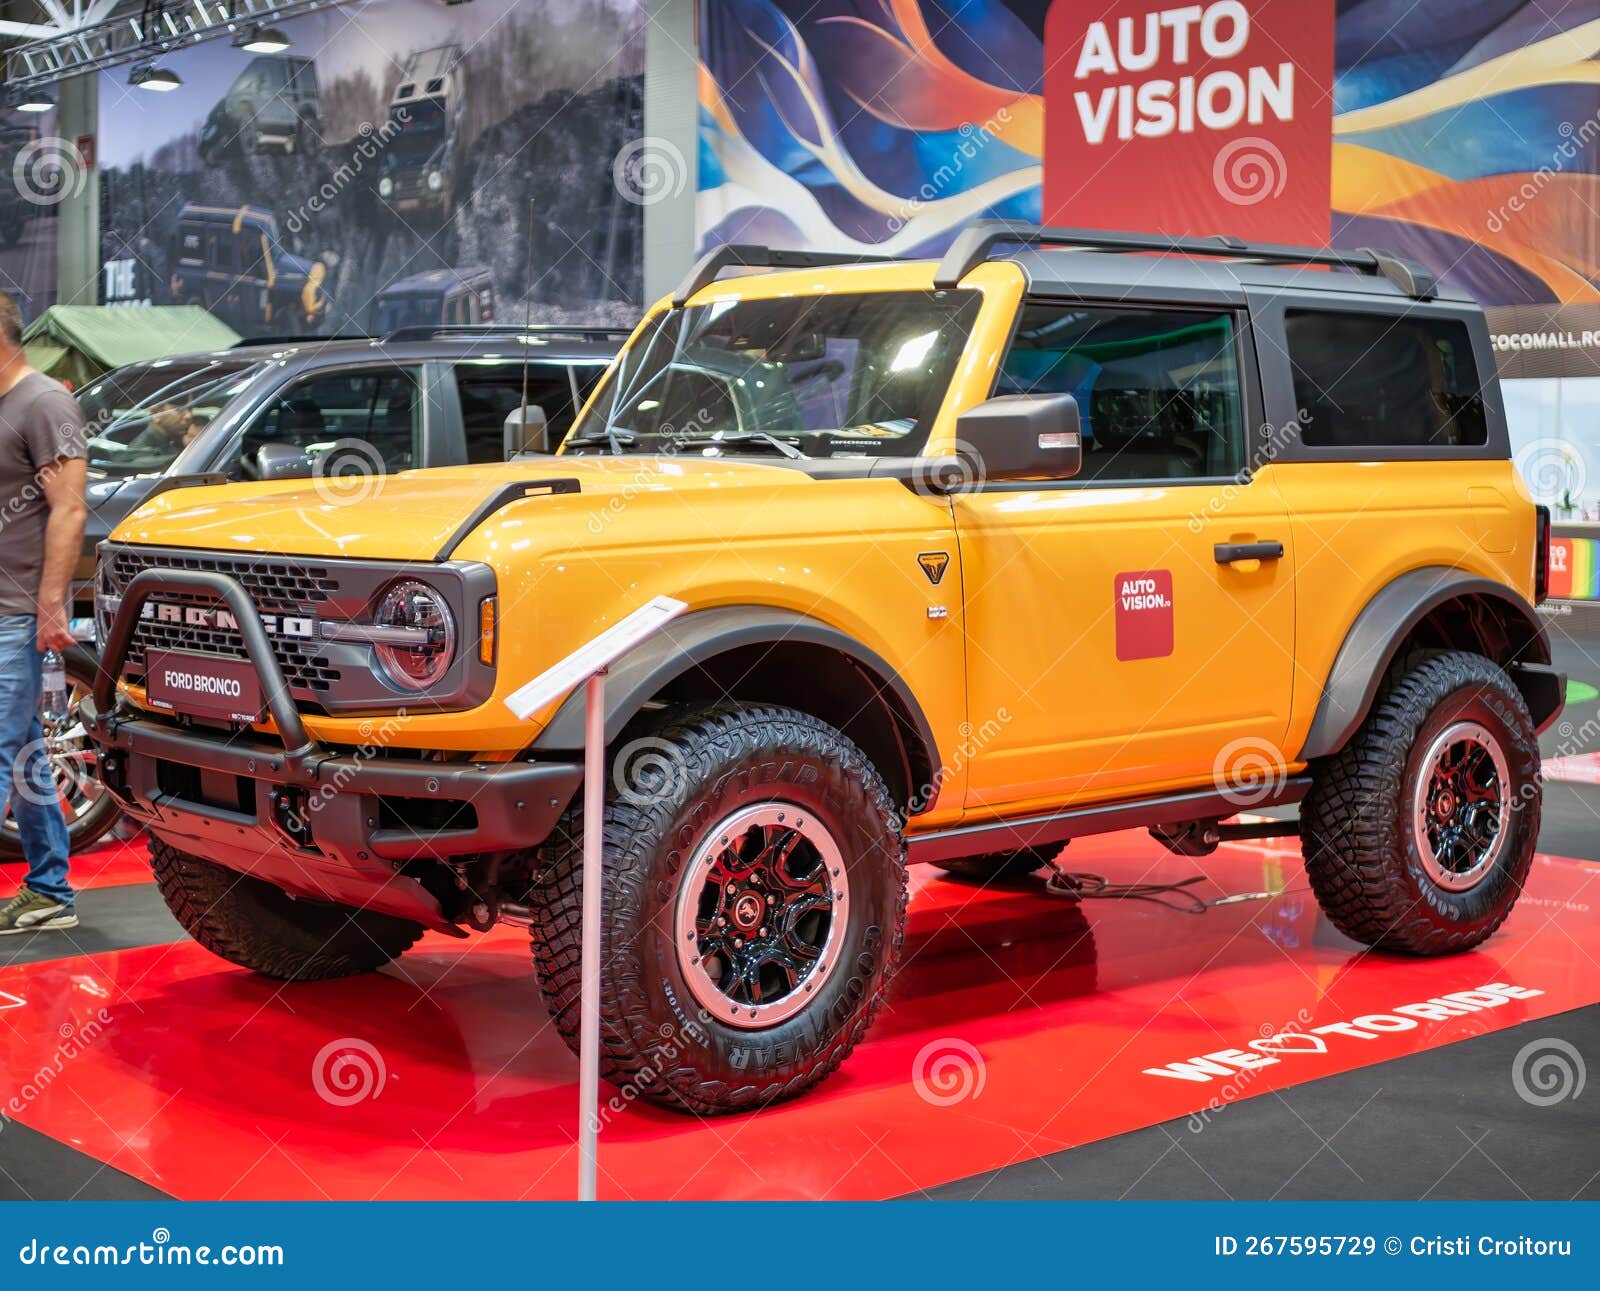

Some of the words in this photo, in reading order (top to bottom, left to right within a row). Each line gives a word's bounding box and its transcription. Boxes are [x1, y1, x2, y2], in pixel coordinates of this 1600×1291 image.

[1074, 0, 1250, 79] AUTO
[1074, 62, 1295, 145] VISION
[104, 258, 137, 298] THE
[1121, 579, 1156, 595] AUTO
[164, 670, 193, 690] FORD
[194, 675, 241, 697] BRONCO
[1142, 1049, 1281, 1083] WE
[1309, 1012, 1419, 1041] TO
[1398, 982, 1545, 1023] RIDE
